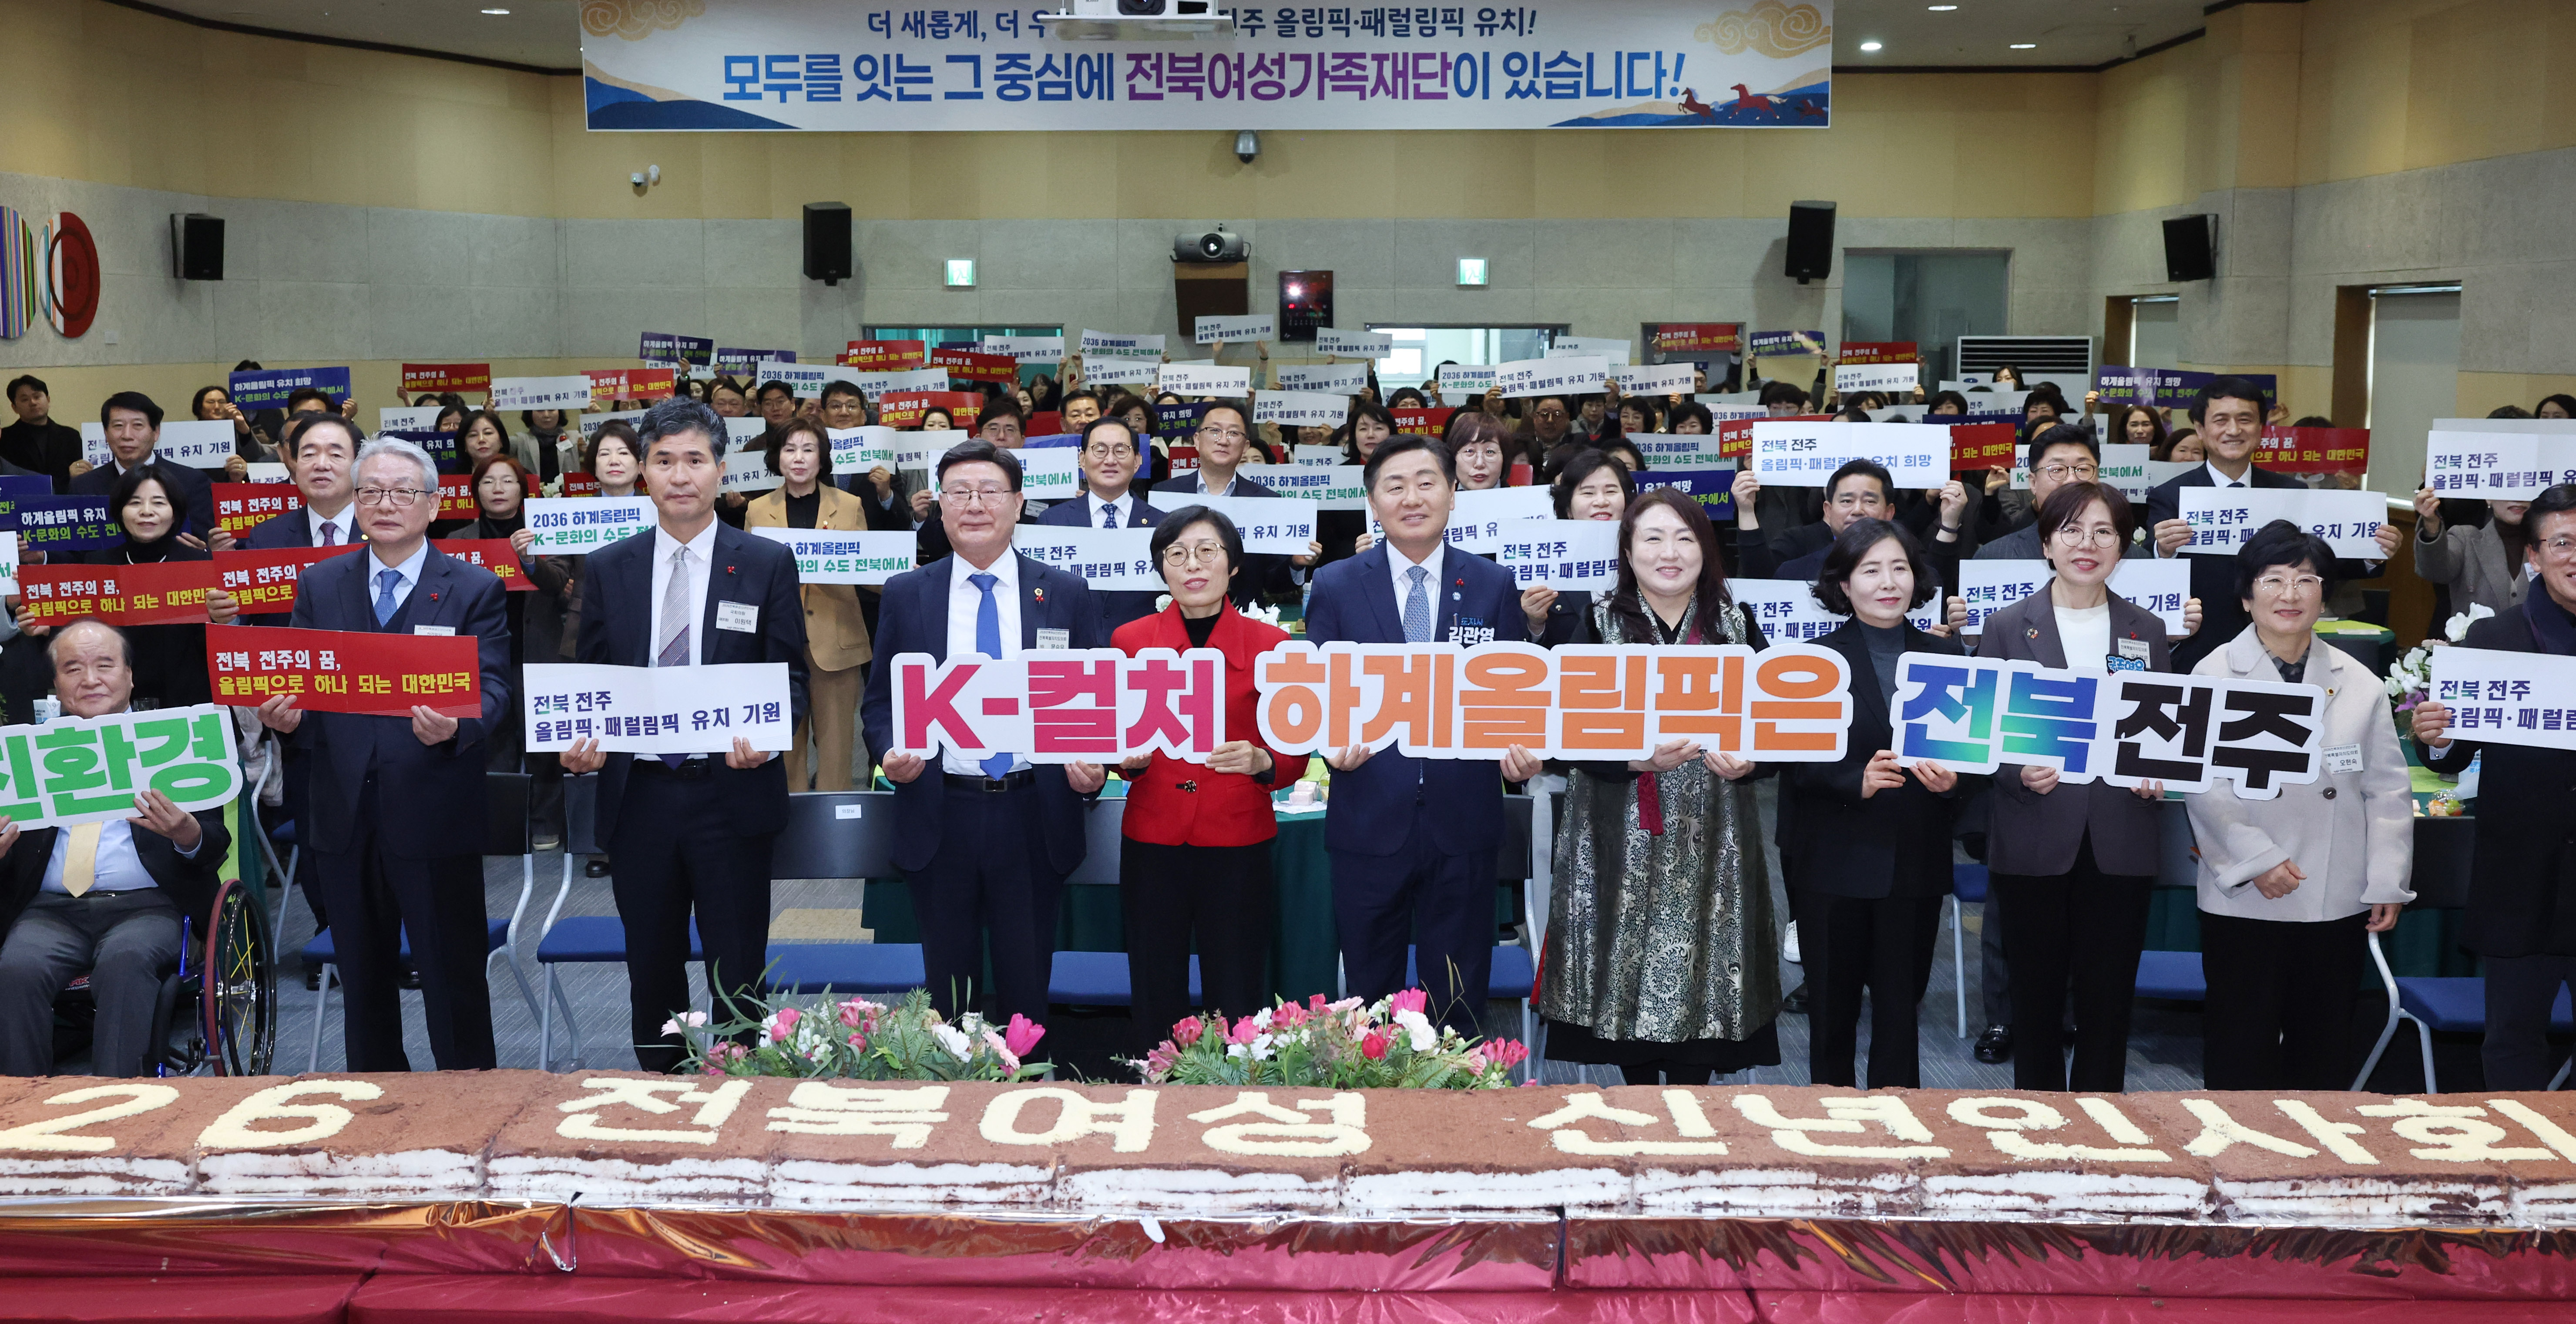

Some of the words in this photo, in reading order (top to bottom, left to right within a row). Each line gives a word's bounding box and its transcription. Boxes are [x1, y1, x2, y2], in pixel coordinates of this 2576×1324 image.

[868, 11, 891, 39] 더
[901, 11, 987, 42] 새롭게,
[996, 11, 1019, 39] 더
[1274, 8, 1464, 37] 올림픽·패럴림픽
[1474, 8, 1536, 37] 유치!
[723, 54, 843, 102] 모두를
[854, 54, 933, 101] 잇는
[945, 54, 984, 101] 그
[993, 53, 1114, 101] 중심에
[1126, 50, 1490, 101] 전북여성가족재단이
[1503, 50, 1685, 99] 있습니다!
[1081, 347, 1113, 355] K-문화의
[762, 370, 782, 379] 2036
[785, 370, 824, 380] 하계올림픽
[1333, 379, 1347, 387] 유치
[1350, 377, 1364, 386] 기원
[1500, 374, 1514, 383] 전북
[1516, 370, 1532, 381] 전주
[1568, 374, 1585, 385] 유치
[1589, 371, 1605, 382] 기원
[2101, 376, 2142, 386] 하계올림픽
[2145, 377, 2161, 386] 유치
[2165, 377, 2181, 386] 희망
[235, 379, 275, 391] 하계올림픽
[277, 379, 292, 389] 유치
[296, 377, 311, 387] 희망
[802, 383, 817, 391] 수도
[915, 383, 928, 392] 유치
[932, 381, 946, 390] 기원
[1162, 382, 1212, 391] 올림픽·패럴림픽
[235, 390, 270, 403] K-문화의
[273, 390, 289, 401] 수도
[555, 392, 569, 401] 유치
[573, 390, 588, 399] 기원
[882, 402, 896, 413] 전북
[898, 400, 918, 410] 전주의
[921, 399, 930, 409] 꿈,
[1257, 401, 1269, 410] 전북
[1271, 400, 1283, 409] 전주
[1256, 410, 1306, 419] 올림픽·패럴림픽
[1310, 410, 1325, 418] 유치
[1329, 410, 1343, 418] 기원
[181, 444, 202, 457] 유치
[209, 442, 230, 454] 기원
[1656, 441, 1699, 452] 하계올림픽
[1762, 440, 1787, 452] 전북
[1791, 438, 1817, 451] 전주
[2284, 437, 2295, 448] 꿈,
[835, 451, 857, 464] 수도
[860, 449, 893, 462] 전북에서
[1962, 448, 1978, 458] 되는
[1983, 443, 2012, 456] 대한민국
[2279, 450, 2297, 462] 하나
[2303, 450, 2321, 461] 되는
[2327, 448, 2364, 461] 대한민국
[1674, 454, 1691, 464] 수도
[1761, 456, 1855, 471] 올림픽·패럴림
[1904, 454, 1932, 467] 희망
[2434, 454, 2462, 469] 전북
[2467, 453, 2498, 468] 전주
[1023, 472, 1072, 487] 전북에서
[2099, 466, 2142, 478] 전북에서
[1279, 474, 1330, 487] 하계올림픽
[1672, 479, 1692, 492] 희망
[2432, 471, 2553, 490] 올림픽·패럴림픽
[1326, 487, 1367, 499] 전북에서
[219, 500, 242, 515] 전북
[248, 499, 282, 512] 전주의
[21, 508, 78, 526] 하계올림픽
[84, 507, 106, 521] 유치
[533, 513, 567, 527] 2036
[573, 508, 640, 525] 하계올림픽
[2186, 510, 2213, 526] 전북
[2219, 508, 2249, 524] 전주
[24, 528, 71, 542] K-문화의
[77, 525, 100, 539] 수도
[534, 528, 597, 546] K-문화의
[603, 527, 630, 542] 수도
[1253, 526, 1277, 539] 유치
[1286, 524, 1310, 538] 기원
[2311, 523, 2341, 540] 유치
[2351, 522, 2381, 537] 기원
[796, 541, 860, 555] 하계올림픽
[1020, 546, 1045, 561] 전북
[1050, 545, 1077, 560] 전주
[1504, 543, 1531, 559] 전북
[1536, 542, 1567, 559] 전주
[495, 565, 514, 578] 되는
[824, 558, 849, 573] 수도
[855, 556, 908, 571] 전북에서
[223, 570, 249, 587] 전북
[256, 564, 296, 583] 전주의
[26, 582, 52, 599] 전북
[59, 580, 97, 597] 전주의
[104, 579, 120, 595] 꿈,
[1967, 586, 1995, 602] 전북
[2002, 582, 2034, 600] 전주
[28, 600, 93, 617] 올림픽으로
[101, 598, 125, 612] 하나
[134, 595, 159, 609] 되는
[2148, 593, 2180, 610] 기원
[1763, 602, 1793, 617] 전주
[1449, 626, 1495, 644] 김관영
[216, 652, 249, 671] 전북
[259, 650, 310, 670] 전주의
[319, 651, 341, 672] 꿈,
[218, 675, 305, 696] 올림픽으로
[314, 675, 347, 695] 하나
[358, 675, 392, 694] 되는
[402, 672, 471, 694] 대한민국
[2440, 680, 2479, 701] 전북
[2487, 680, 2530, 701] 전주
[534, 693, 568, 715] 전북
[575, 691, 612, 713] 전주
[535, 713, 679, 742] 올림픽·패럴림픽
[692, 708, 730, 732] 유치
[743, 701, 780, 725] 기원
[902, 659, 1214, 753] K-컬처
[1266, 653, 1842, 751] 하계올림픽은
[1902, 664, 2097, 773] 전북
[2114, 683, 2312, 790] 전주
[555, 1078, 1371, 1157] 전북여성
[1525, 1088, 2576, 1166] 신년인사회
